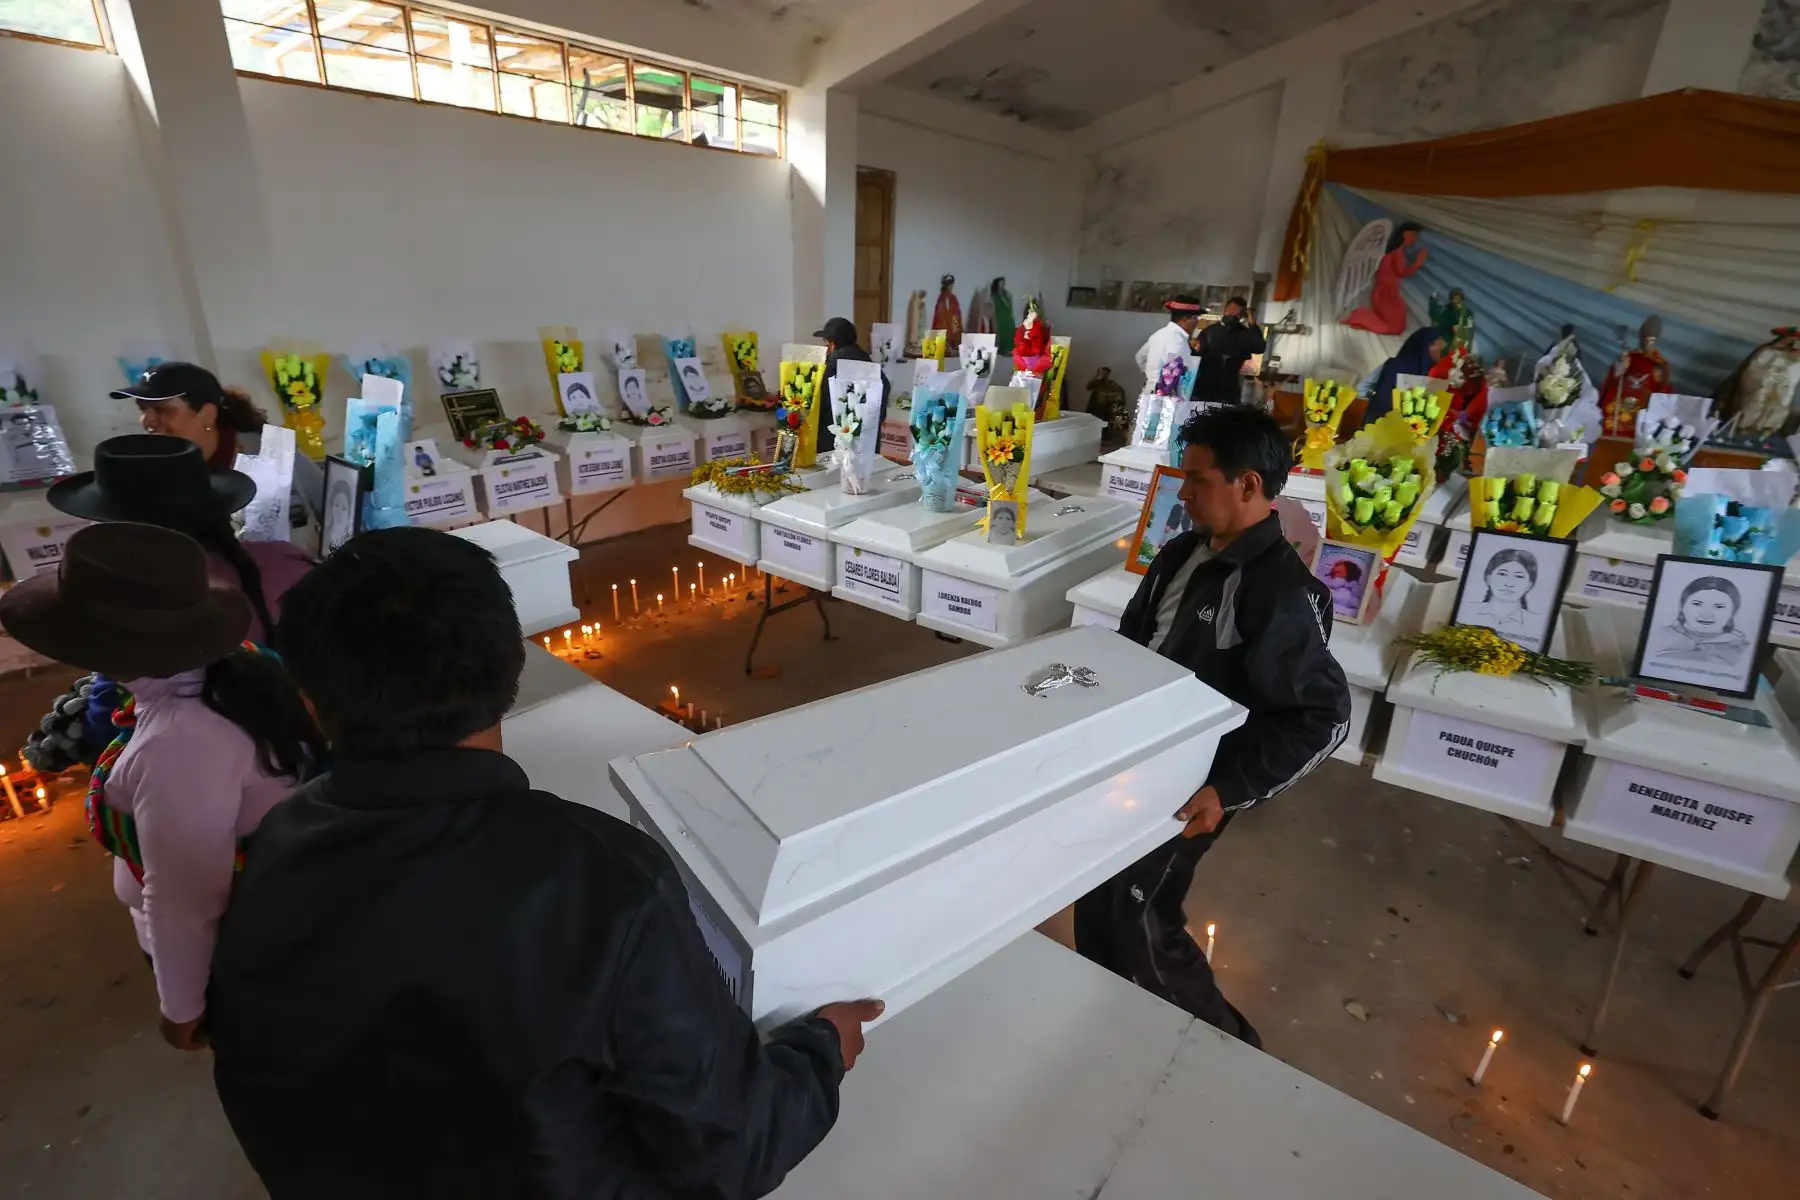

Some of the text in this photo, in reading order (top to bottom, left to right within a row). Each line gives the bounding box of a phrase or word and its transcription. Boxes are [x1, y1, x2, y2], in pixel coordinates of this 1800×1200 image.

[26, 543, 61, 560] WALTER
[864, 565, 880, 582] FLORES
[938, 592, 960, 603] LORENZA
[1439, 730, 1516, 758] PADUA QUISPE
[1447, 746, 1500, 768] CHUCHÓN
[1628, 782, 1755, 825] BENEDICTA QUISPE
[1650, 803, 1719, 831] MARTÍNEZ
